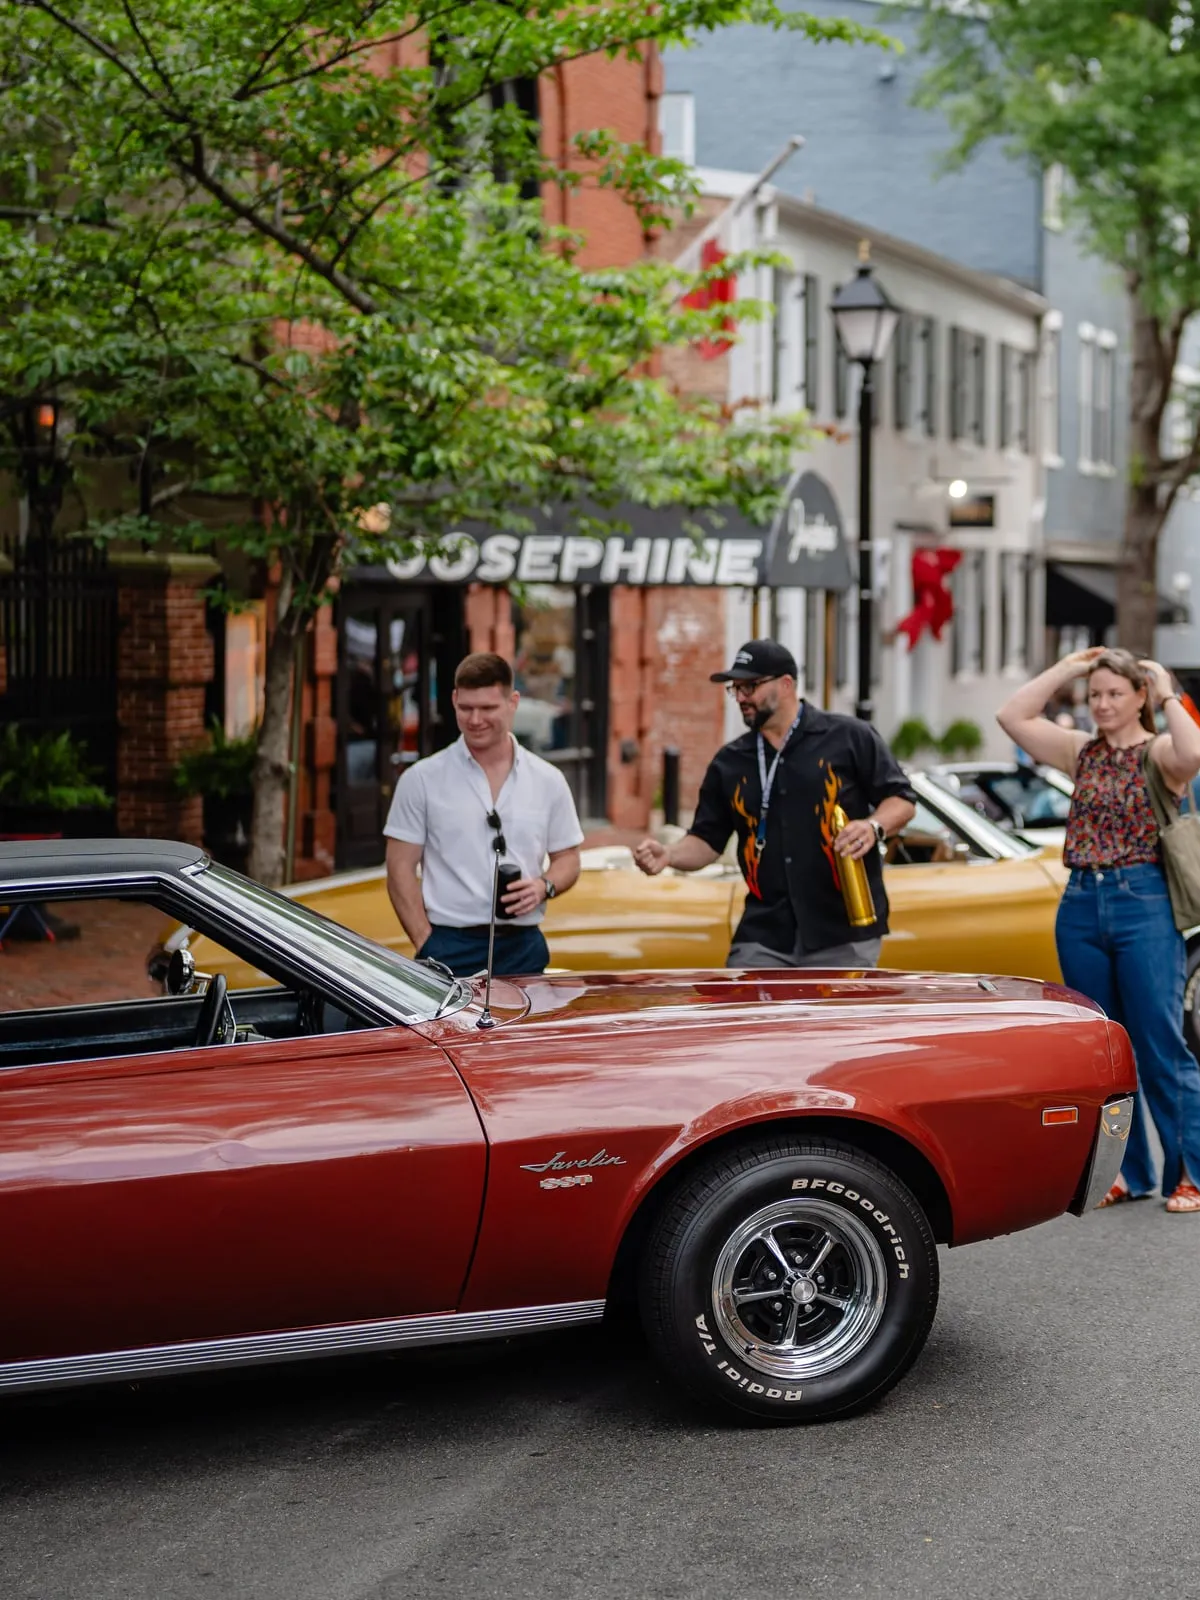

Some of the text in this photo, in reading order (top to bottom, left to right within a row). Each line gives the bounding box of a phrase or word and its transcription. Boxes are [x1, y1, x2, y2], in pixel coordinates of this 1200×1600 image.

[519, 1148, 627, 1172] Javelin
[539, 1174, 593, 1190] SST
[791, 1178, 910, 1279] BFGoodrich
[695, 1313, 803, 1402] Radial T/A
